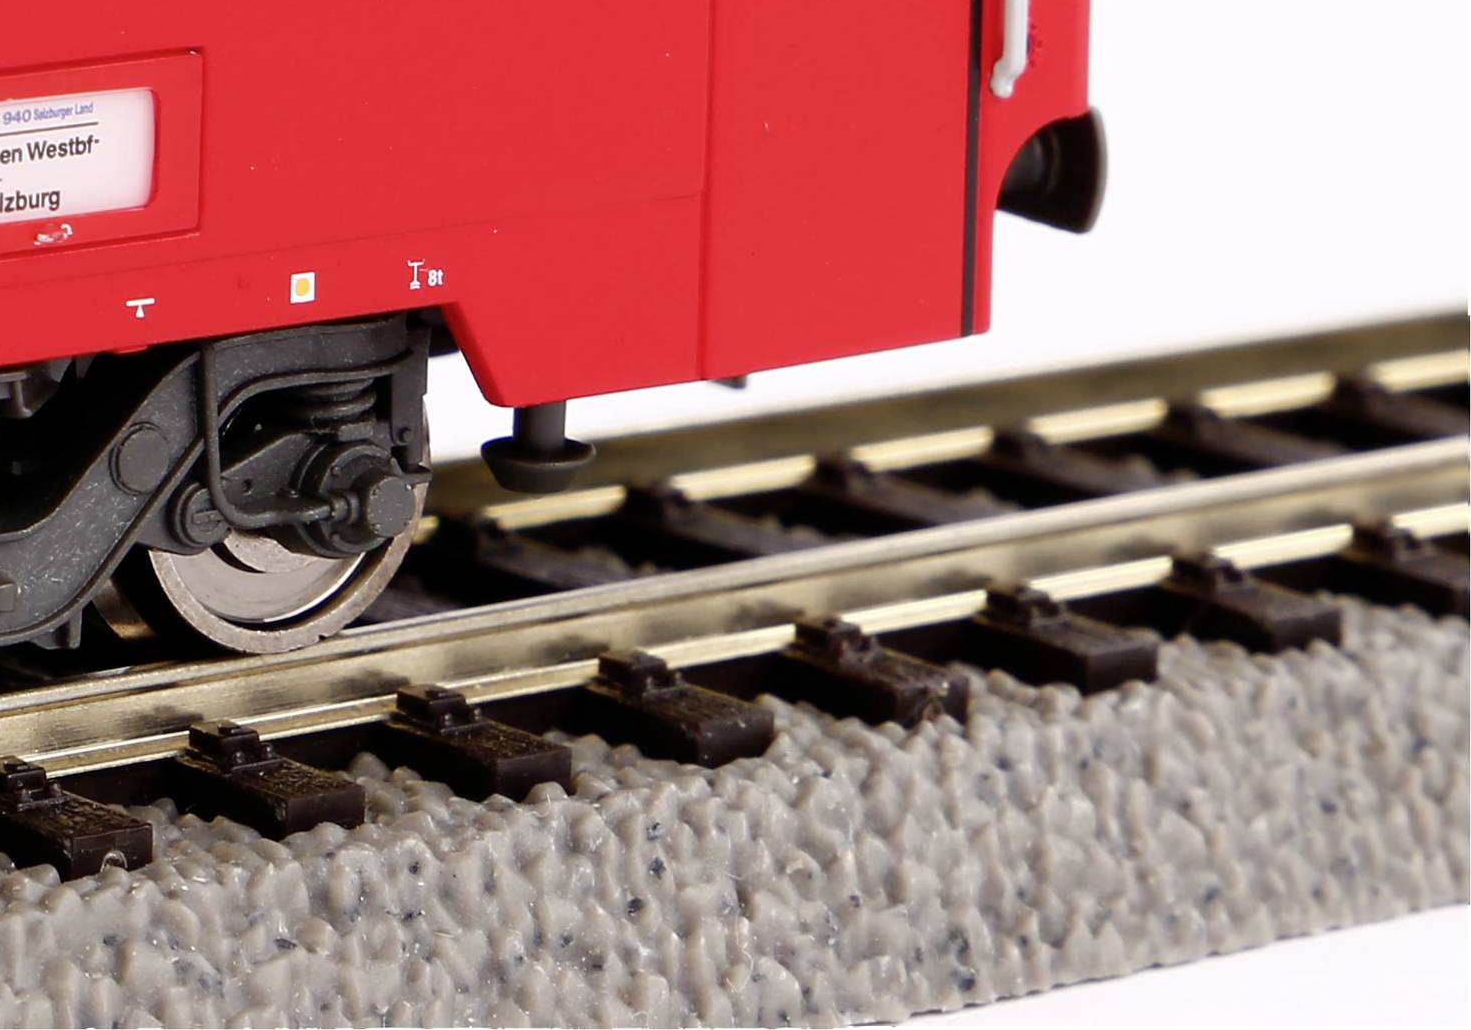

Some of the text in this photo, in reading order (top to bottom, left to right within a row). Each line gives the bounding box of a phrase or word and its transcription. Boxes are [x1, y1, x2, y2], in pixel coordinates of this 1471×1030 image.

[2, 108, 32, 125] 940
[33, 106, 74, 121] Salzburger
[74, 102, 94, 115] Land
